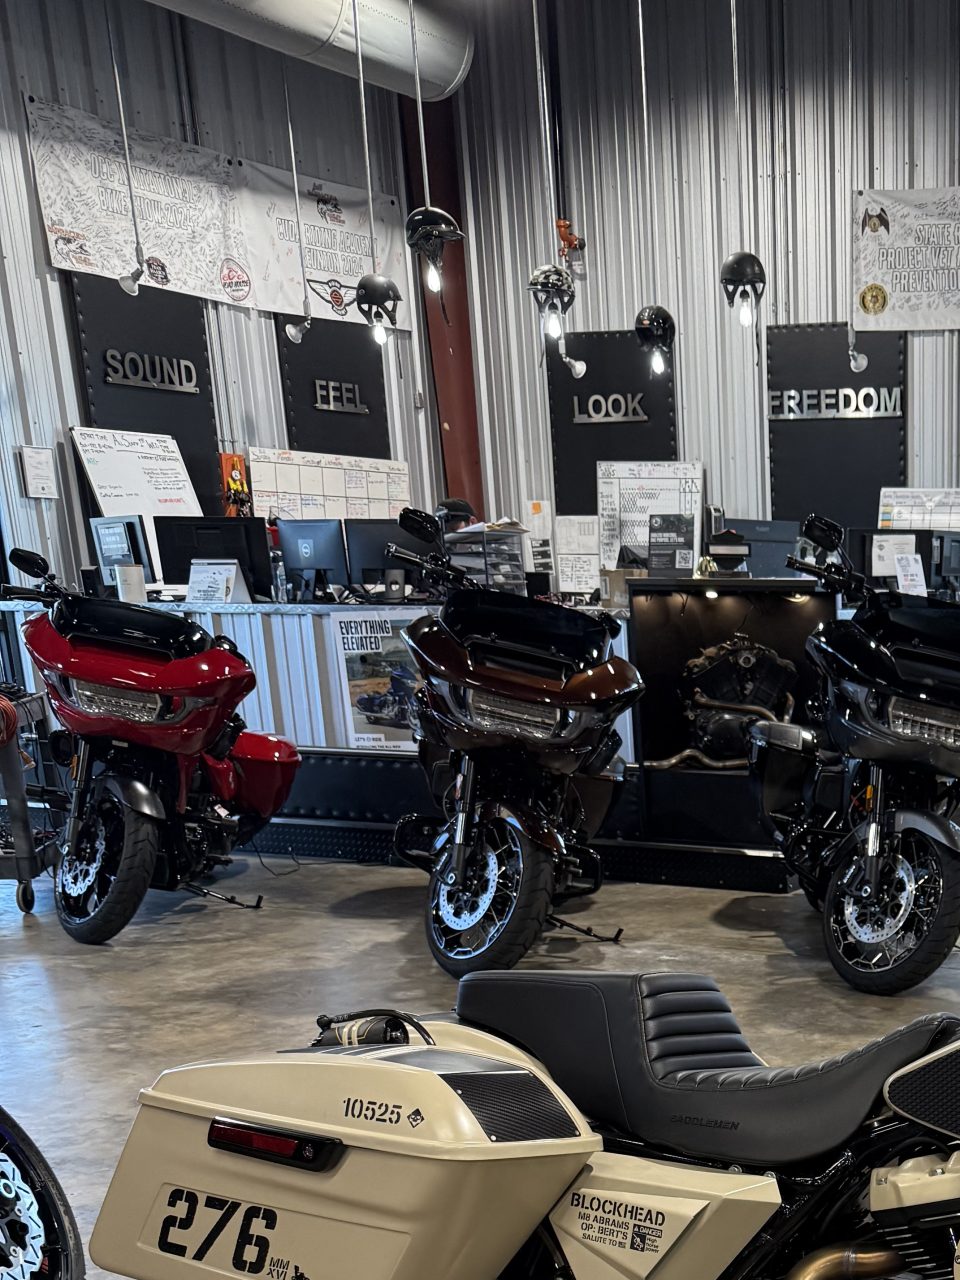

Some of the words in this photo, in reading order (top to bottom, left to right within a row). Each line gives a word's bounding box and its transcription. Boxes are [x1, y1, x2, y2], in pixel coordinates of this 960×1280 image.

[97, 185, 128, 216] BIKE
[304, 224, 337, 250] RIDING
[914, 223, 950, 246] STATE
[304, 247, 340, 275] EUNION
[341, 255, 365, 277] 2024
[878, 246, 928, 270] PROJECT
[929, 246, 955, 269] VET
[106, 348, 197, 387] SOUND
[572, 392, 646, 419] LOOK
[768, 387, 901, 414] FREEDOM
[338, 620, 391, 636] EVERYTHING
[342, 636, 381, 651] ELEVATED
[343, 1098, 402, 1124] 10525
[671, 1114, 741, 1131] SADDLEMEN
[570, 1192, 666, 1227] BLOCKHEAD
[578, 1211, 591, 1222] M8
[592, 1215, 630, 1231] ABRAMS
[158, 1188, 278, 1275] 276
[581, 1222, 596, 1233] OP:
[597, 1226, 628, 1241] BERT'S
[582, 1233, 607, 1245] SALUTE
[608, 1238, 618, 1247] TO
[266, 1268, 288, 1280] XVI
[269, 1257, 290, 1270] MM
